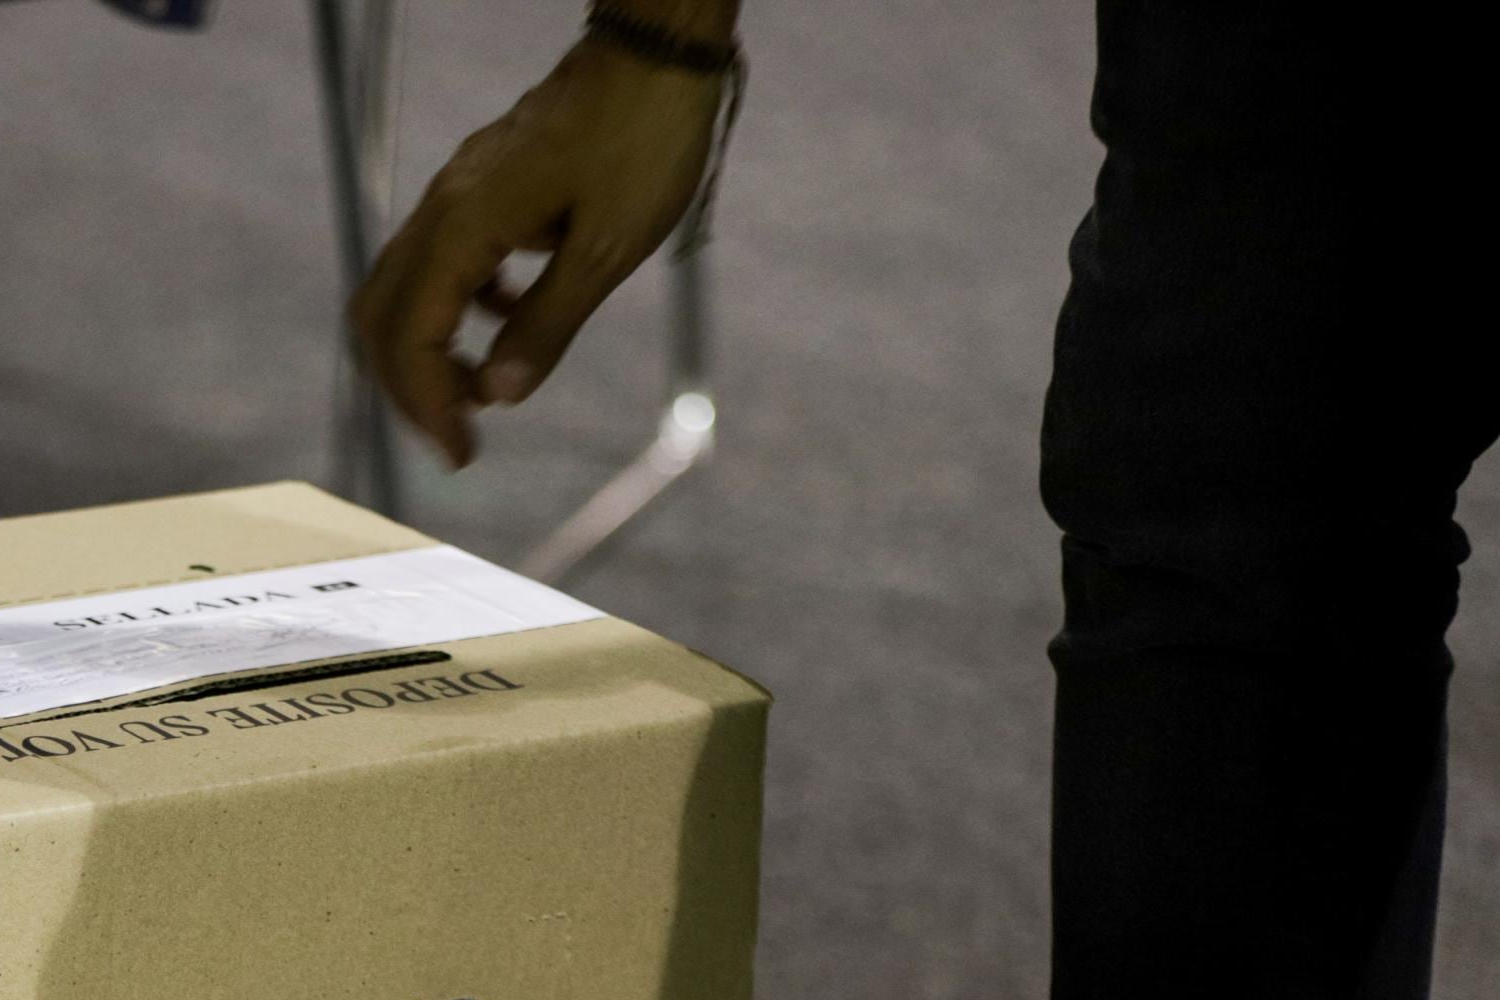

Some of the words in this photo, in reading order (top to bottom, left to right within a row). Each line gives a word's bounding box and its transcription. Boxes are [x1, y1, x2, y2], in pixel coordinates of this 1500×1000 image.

[53, 590, 297, 631] SELLADA
[206, 669, 525, 730] DEPOSITE
[119, 715, 210, 744] SU
